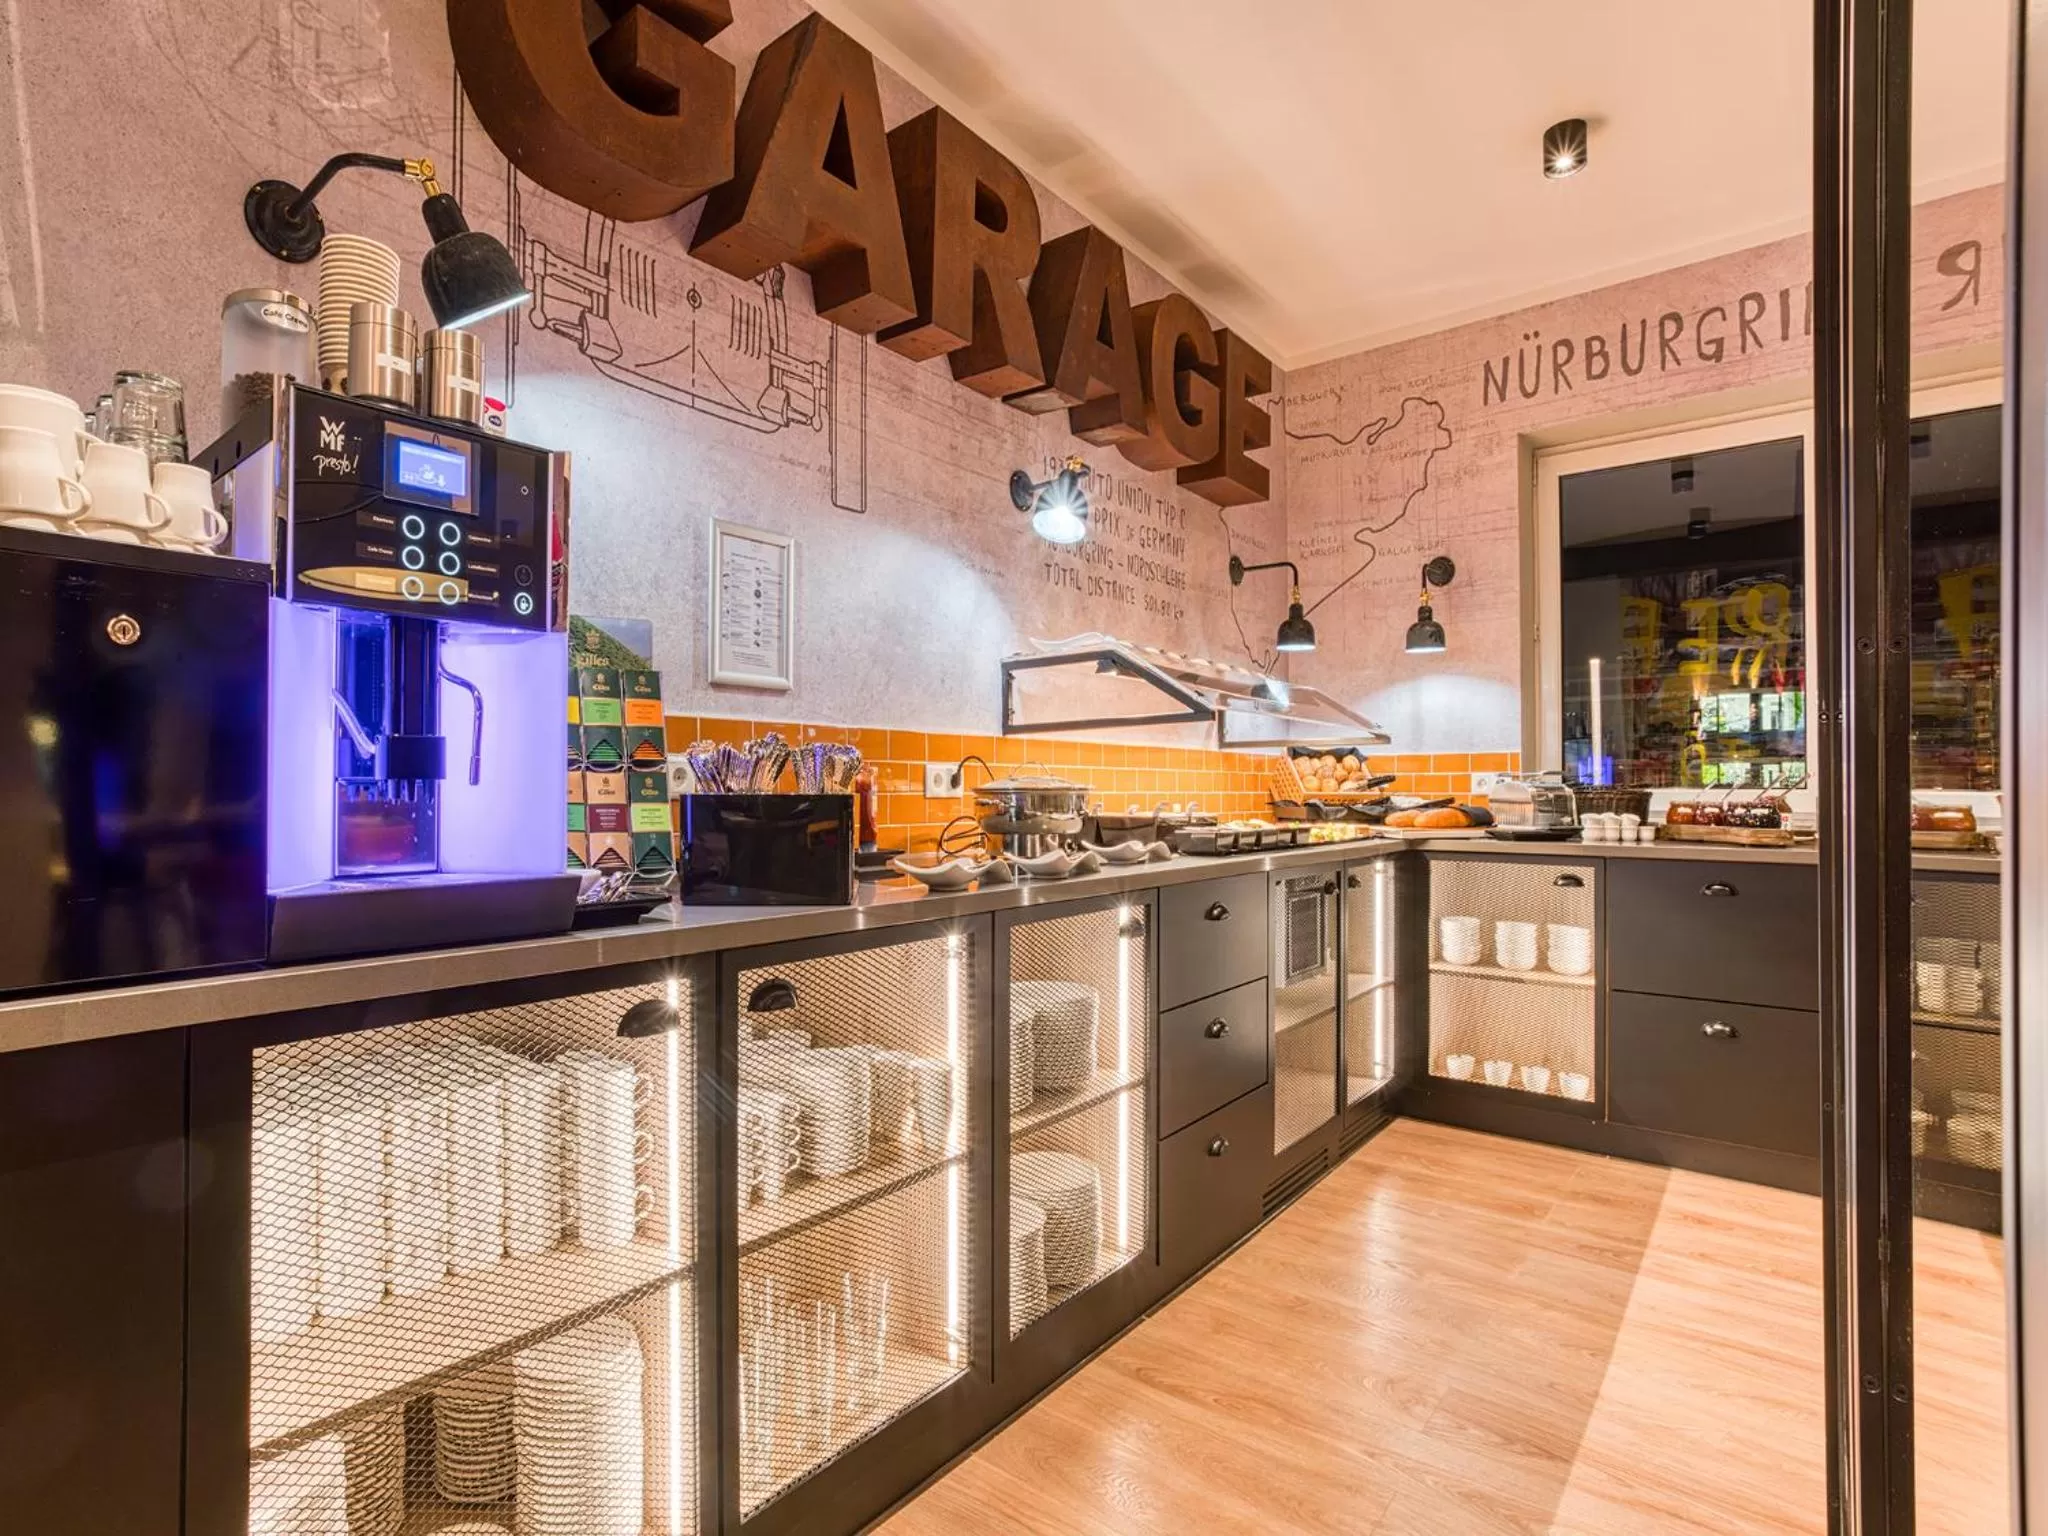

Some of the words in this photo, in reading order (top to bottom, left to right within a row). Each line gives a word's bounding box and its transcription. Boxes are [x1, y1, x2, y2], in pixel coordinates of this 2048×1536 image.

[447, 0, 1273, 507] GARAGE
[1483, 281, 1813, 406] NÜRBURGRI
[1117, 480, 1152, 518] UNION
[1139, 524, 1186, 562] GERMANY
[1044, 562, 1082, 591] TOTAL
[1088, 575, 1135, 605] DISTANCE
